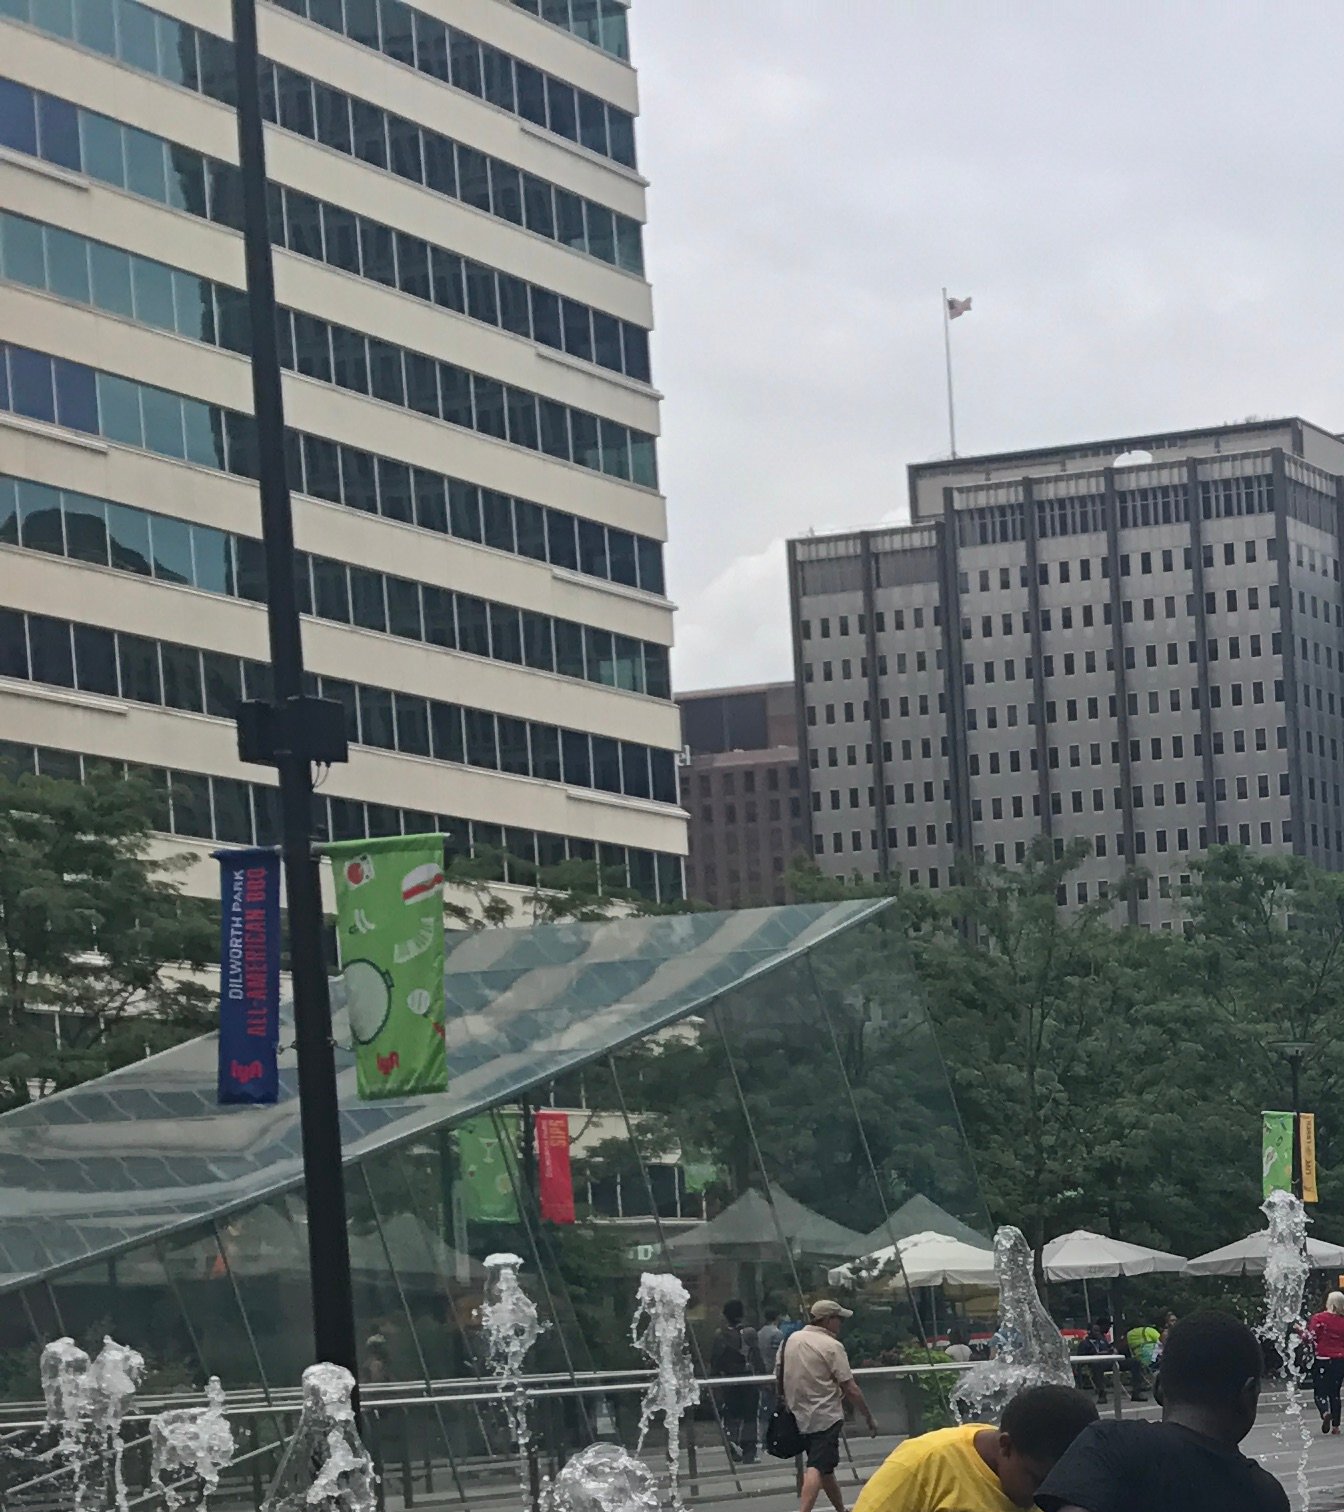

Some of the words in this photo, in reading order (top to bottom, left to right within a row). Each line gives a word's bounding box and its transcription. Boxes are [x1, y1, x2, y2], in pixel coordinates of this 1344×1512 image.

[232, 869, 244, 912] PARK
[229, 915, 243, 1000] DILWORTH
[244, 909, 268, 1037] ALL-AMERICAN
